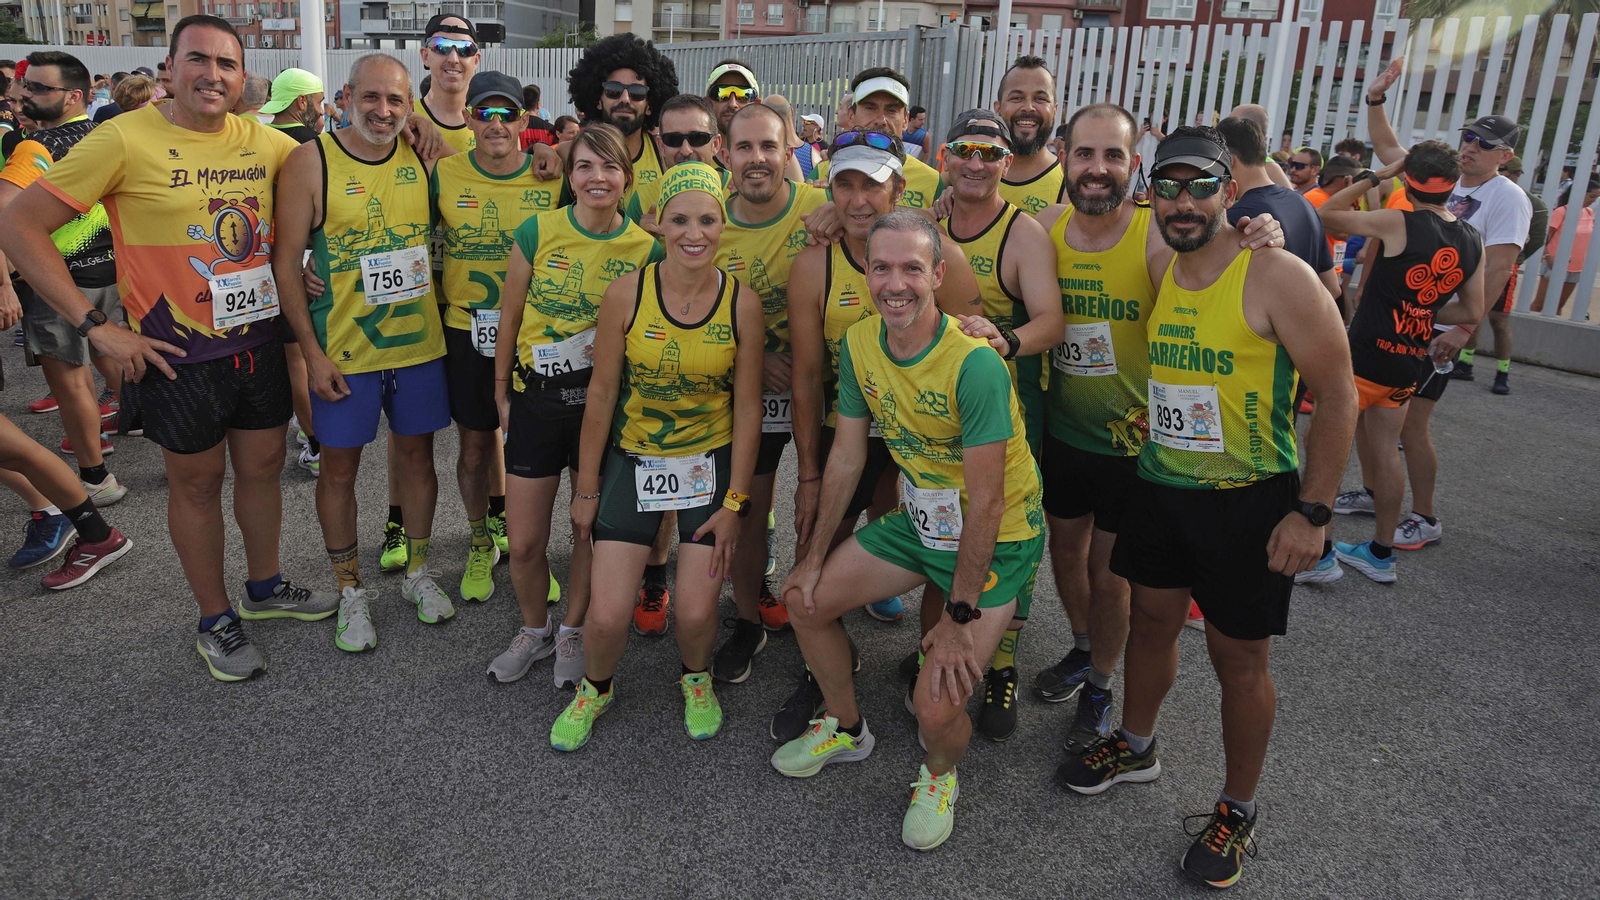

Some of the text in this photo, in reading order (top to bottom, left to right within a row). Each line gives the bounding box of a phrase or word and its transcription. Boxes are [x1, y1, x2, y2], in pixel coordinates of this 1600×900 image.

[169, 163, 266, 189] EL MADRUGÓN
[369, 269, 403, 291] 756
[1058, 277, 1103, 292] RUNNERS
[226, 288, 257, 312] 924
[1061, 292, 1140, 322] RREÑOS
[1157, 323, 1196, 340] RUNNERS
[1157, 404, 1184, 431] 893
[1245, 391, 1258, 420] VILLA
[643, 473, 679, 495] 420
